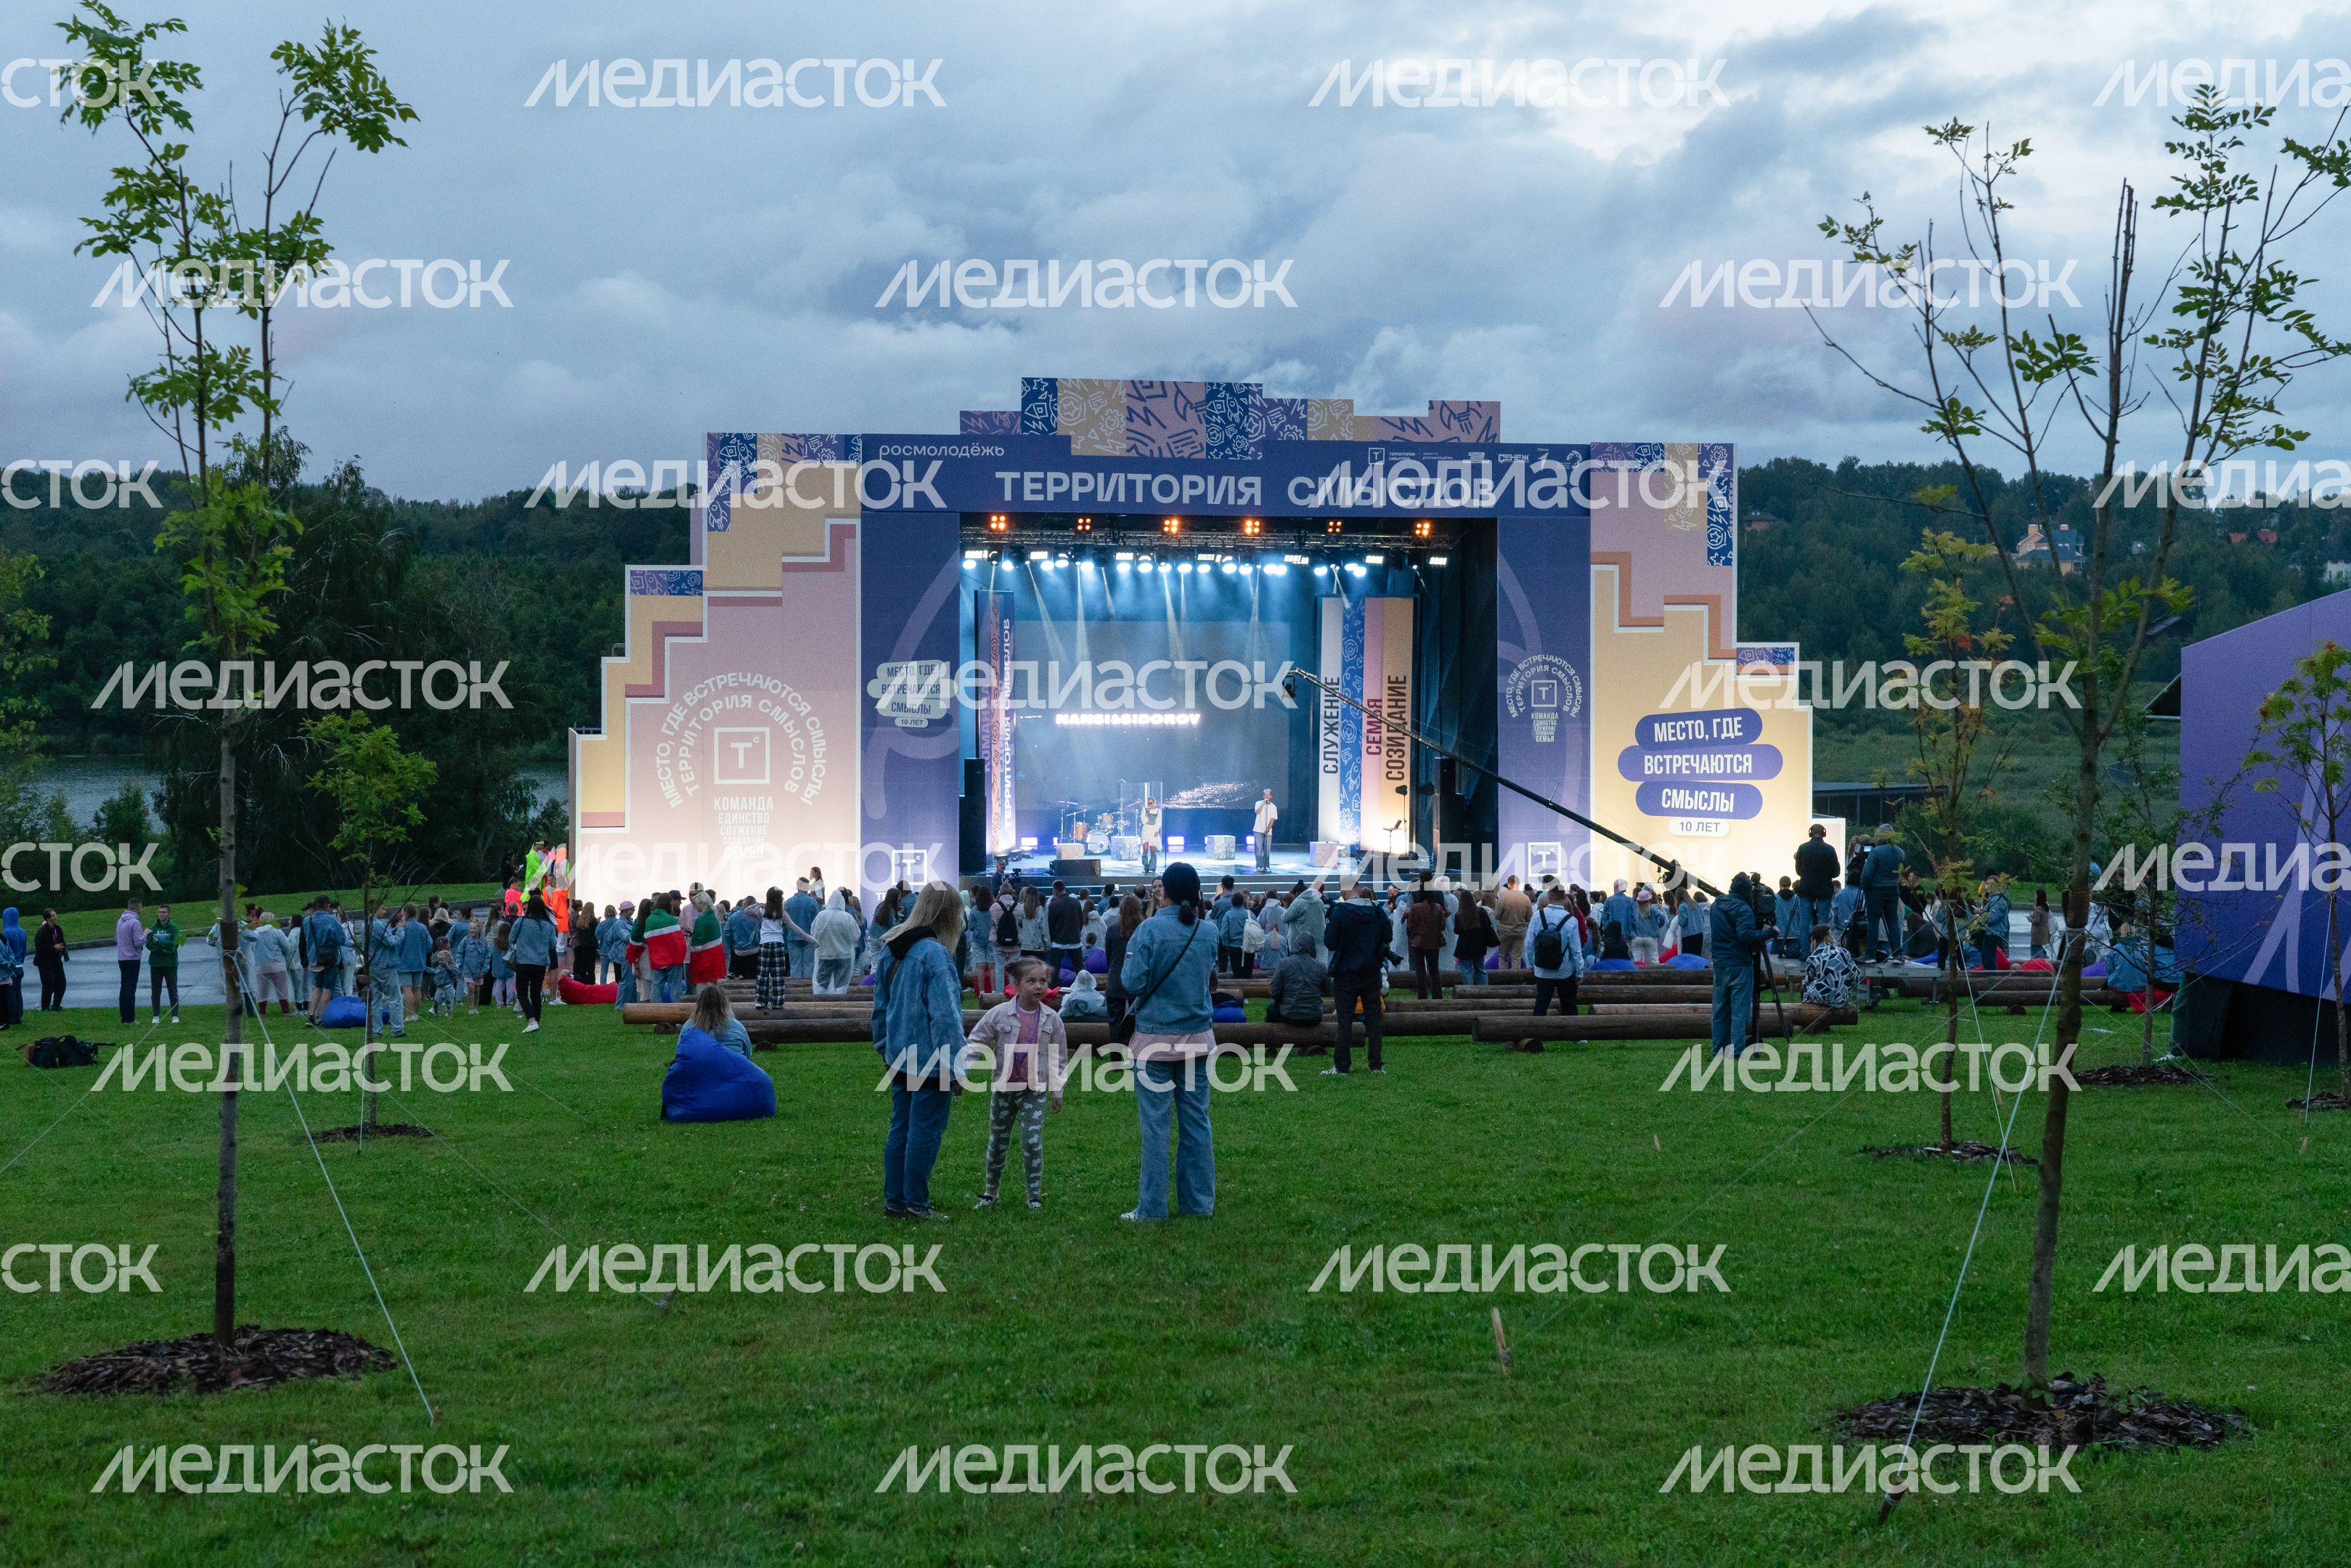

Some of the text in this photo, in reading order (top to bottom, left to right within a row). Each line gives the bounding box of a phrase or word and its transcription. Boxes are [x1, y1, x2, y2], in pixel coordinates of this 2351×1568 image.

[879, 443, 1004, 461] росмолодёжь
[995, 471, 1496, 507] ТЕРРИТОРИЯ СМЫСЛОВ
[919, 664, 936, 676] ГДЕ
[881, 684, 941, 695] ВСТРЕЧАЮТСЯ
[1508, 668, 1520, 685] ГДЕ
[1518, 654, 1576, 676] ВСТРЕЧАЮТСЯ
[1570, 675, 1583, 717] СМЫСЛЫ
[1516, 664, 1573, 713] ТЕРРИТОРИЯ СМЫСЛОВ
[891, 701, 931, 715] СМЫСЛЫ
[1654, 716, 1743, 743] МЕСТО, ГДЕ
[661, 702, 688, 737] ГДЕ
[682, 672, 812, 717] ВСТРЕЧАЮТСЯ
[800, 716, 827, 806] СМЫСЛЫ
[678, 694, 806, 797] ТЕРРИТОРИЯ СМЫСЛОВ
[1644, 754, 1752, 775] ВСТРЕЧАЮТСЯ
[714, 796, 773, 811] КОМАНДА
[1661, 788, 1735, 812] СМЫСЛЫ
[718, 812, 770, 825] ЕДИНСТВО
[1679, 822, 1721, 833] 10 ЛЕТ
[720, 825, 767, 836] СЛУЖЕНИЕ
[723, 846, 764, 859] СЕМЬЯ
